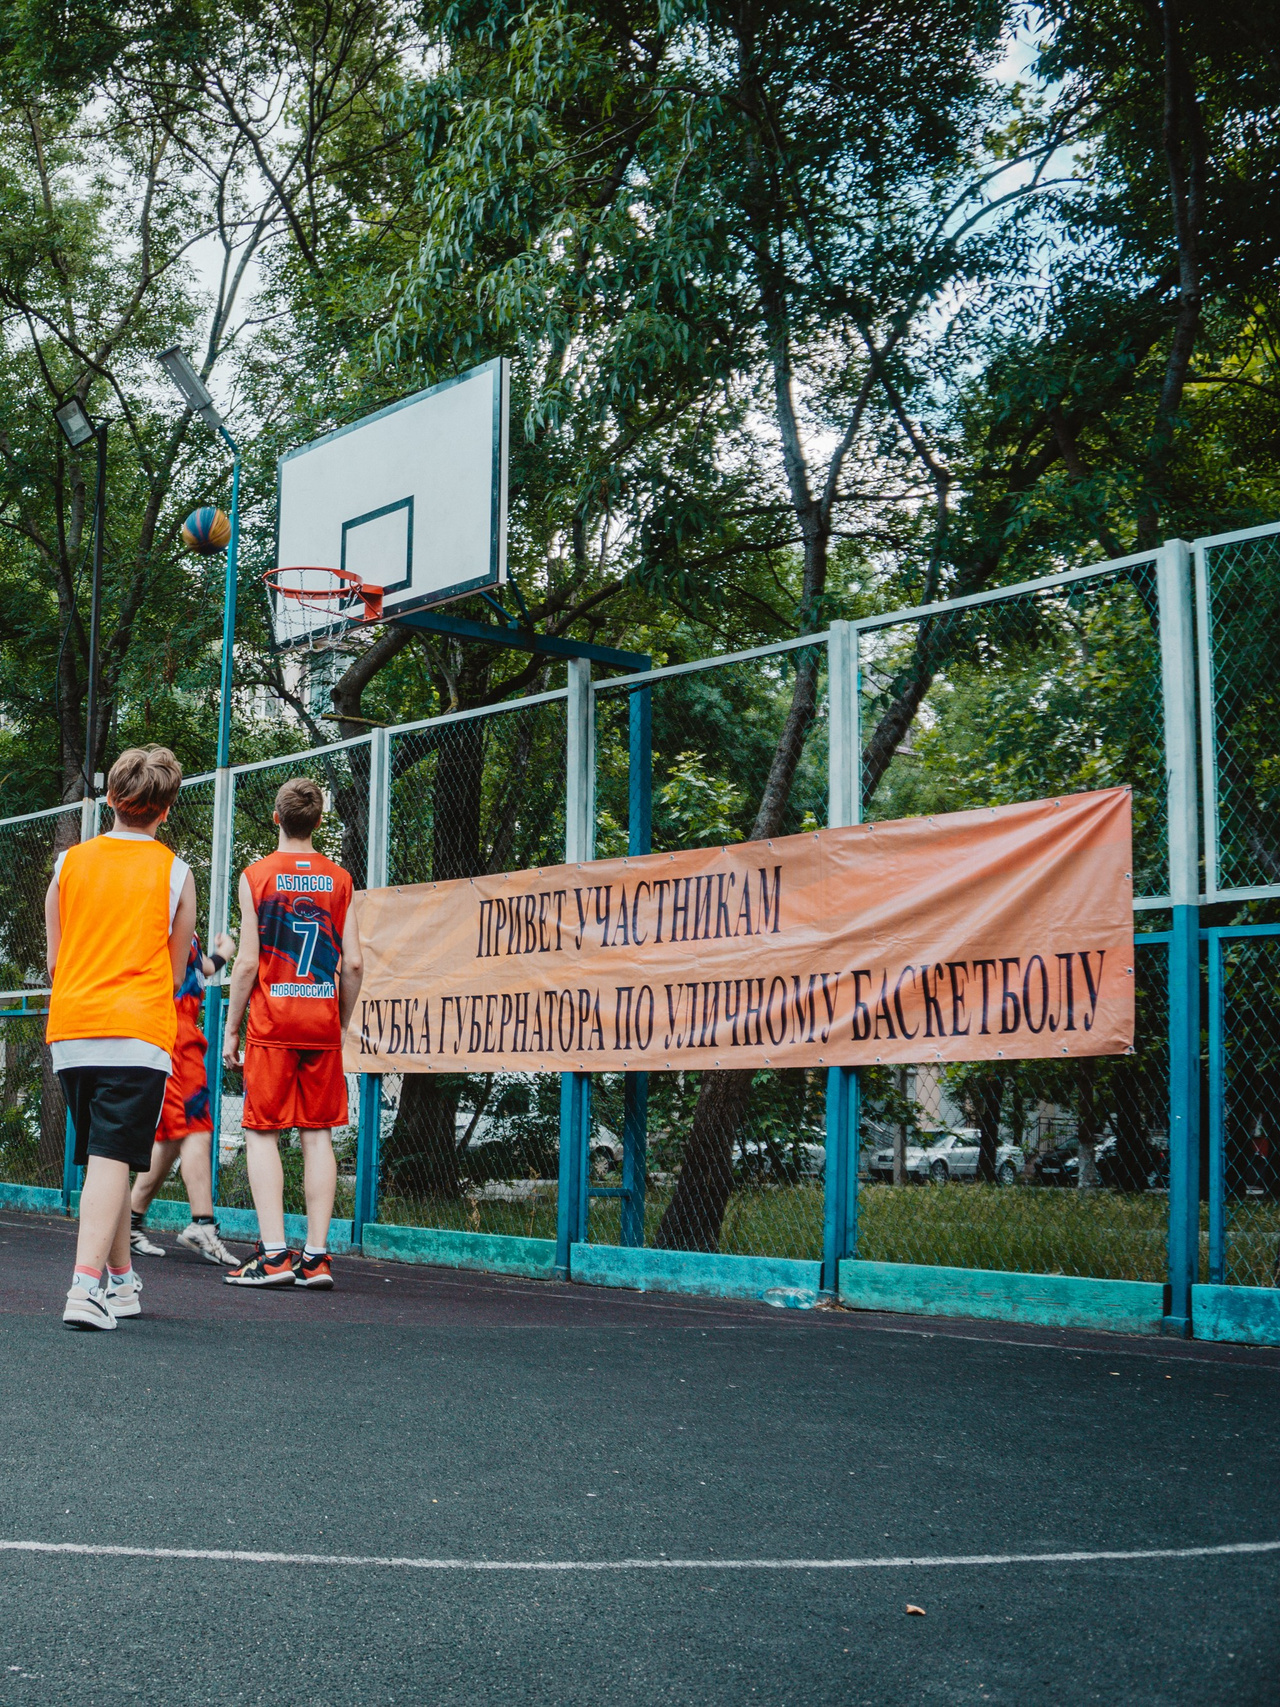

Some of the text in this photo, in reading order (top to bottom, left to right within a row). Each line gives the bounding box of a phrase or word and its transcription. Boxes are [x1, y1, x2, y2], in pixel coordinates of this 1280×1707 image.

[276, 874, 334, 893] АБЛЯСОВ
[476, 865, 782, 958] ПРИВЕТ УЧАСТНИКАМ
[293, 922, 320, 977] 7
[360, 950, 1106, 1055] КУБКА ГУБЕРНАТОРА ПО УЛИЧНОМУ БАСКЕТБОЛУ
